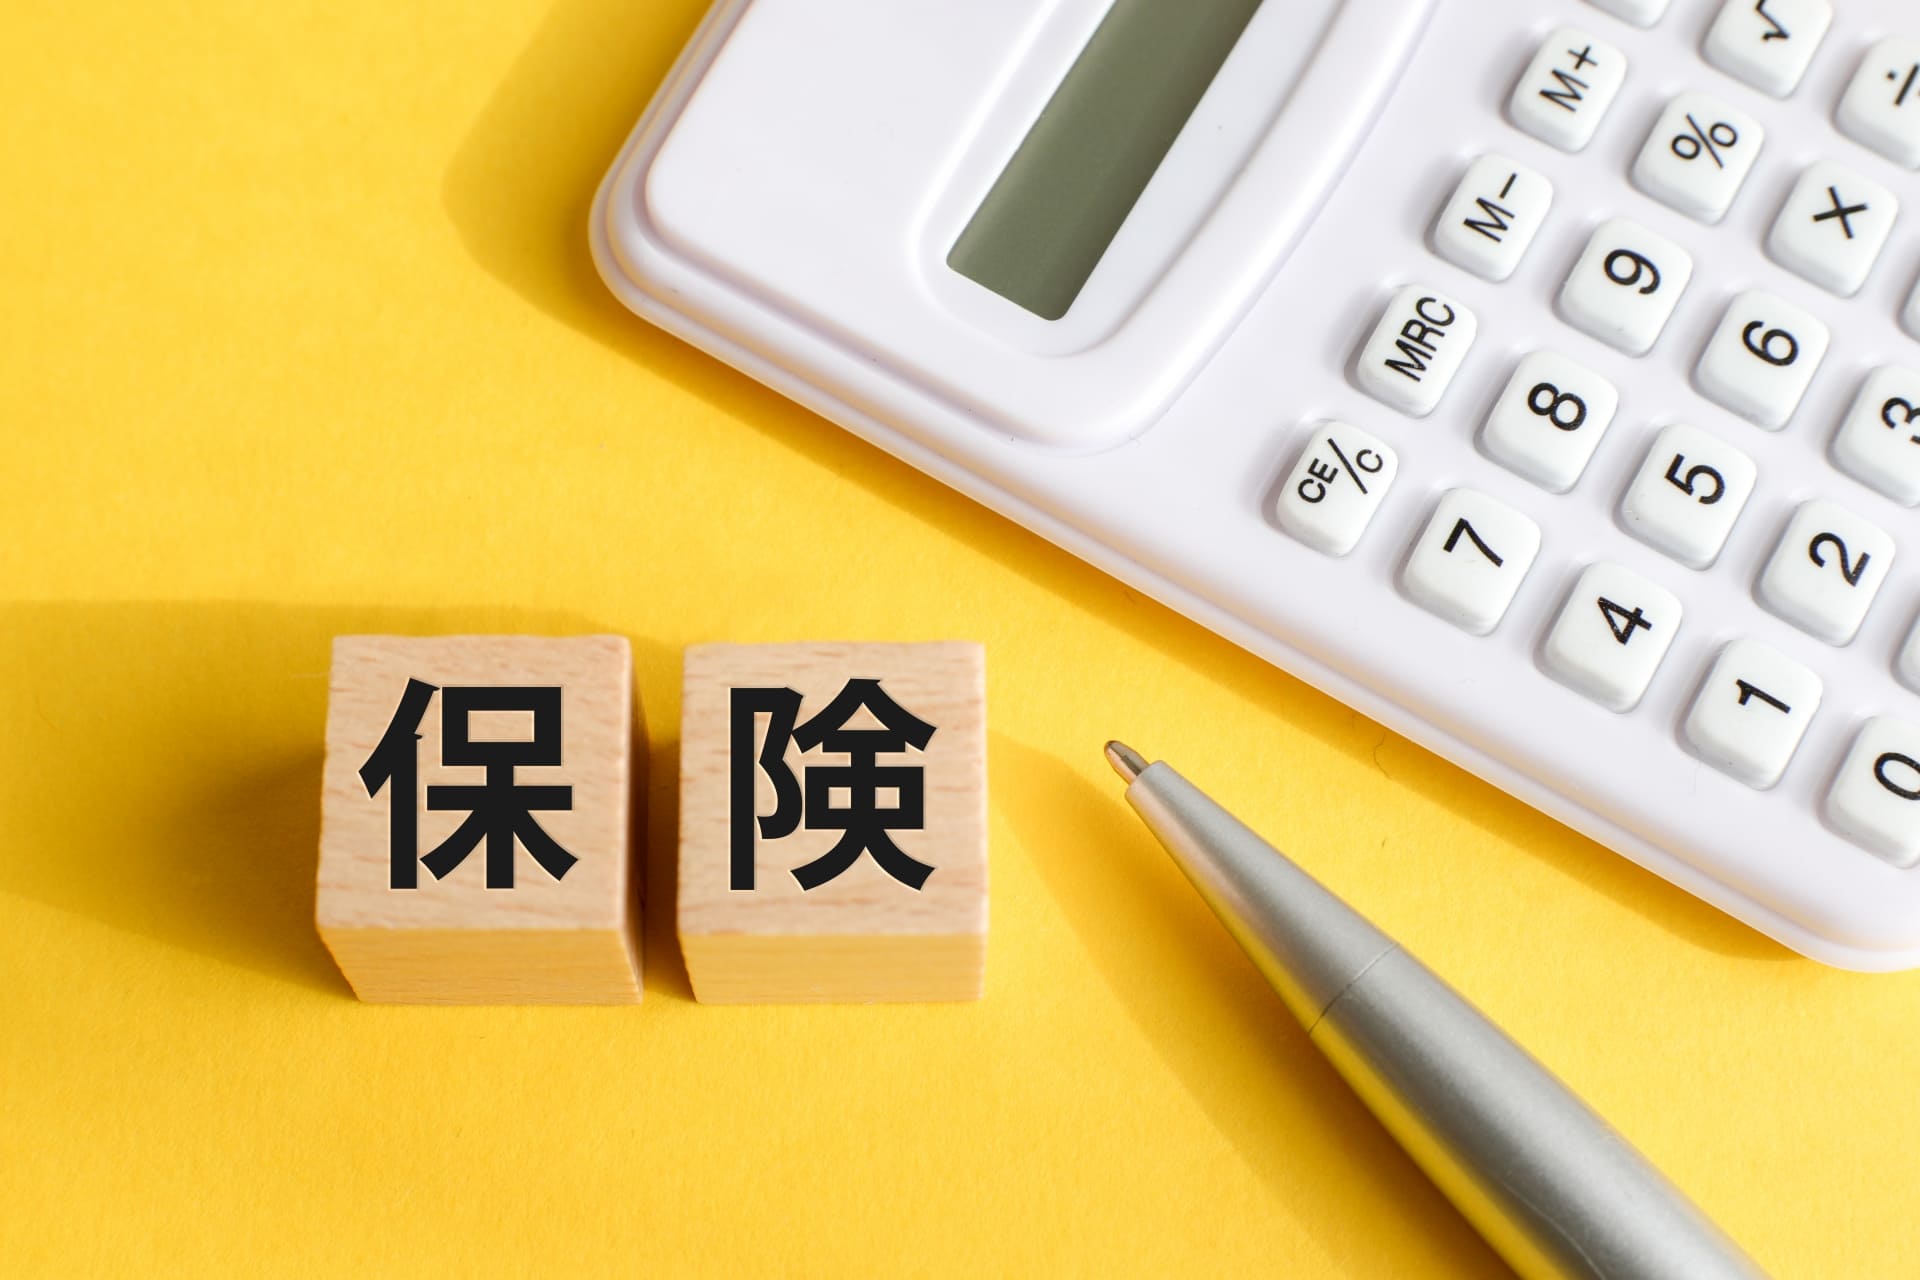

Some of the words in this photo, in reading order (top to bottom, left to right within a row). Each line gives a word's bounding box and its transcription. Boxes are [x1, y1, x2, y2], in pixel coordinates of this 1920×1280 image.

[1539, 45, 1599, 112] M+
[1671, 114, 1738, 170] %
[1603, 248, 1661, 296] 9
[1384, 296, 1456, 383] MRC
[1741, 319, 1799, 368] 6
[1526, 381, 1587, 433] 8
[1297, 437, 1384, 505] CE/C
[1663, 452, 1726, 506] 5
[1442, 516, 1504, 568] 7
[1808, 531, 1870, 587] 2
[1597, 595, 1653, 646] 4
[1735, 677, 1791, 715] 1
[1872, 751, 1920, 802] 0
